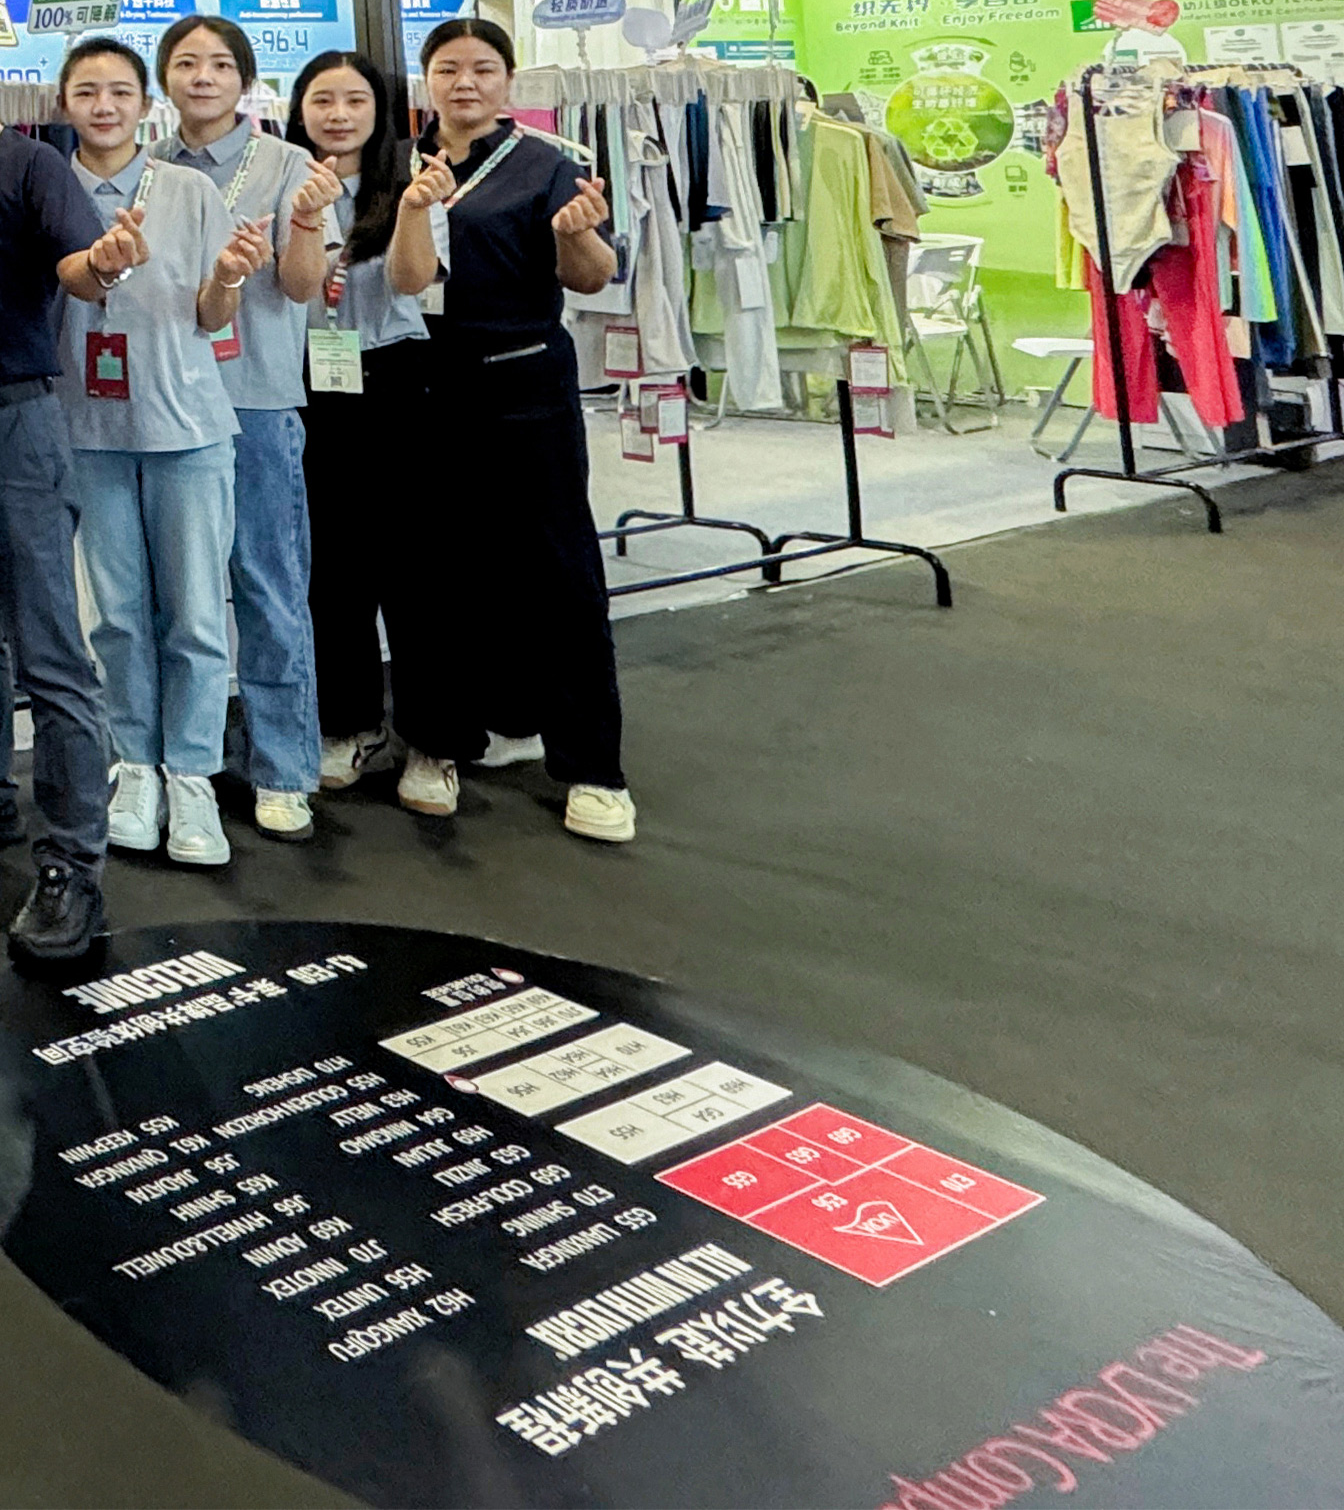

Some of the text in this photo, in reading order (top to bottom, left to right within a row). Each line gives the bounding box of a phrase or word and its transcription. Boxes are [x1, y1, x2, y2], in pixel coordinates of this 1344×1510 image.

[835, 7, 1060, 34] Beyond Knit Enjoy Freedom
[62, 950, 247, 1014] WELCOME
[313, 1055, 353, 1074] H70
[211, 1072, 386, 1139] H55 GOLDEN HORIZON
[329, 1088, 421, 1128] H63 WELLY
[339, 1107, 455, 1154] G64 MINGMAO
[58, 1115, 180, 1164] K55 KEEPWIN
[392, 1124, 494, 1168] H69 JULIAN
[608, 1123, 644, 1141] H55
[784, 1146, 821, 1165] G63
[827, 1126, 862, 1145] G69
[74, 1133, 211, 1189] K61 QINXINGFA
[124, 1153, 241, 1205] J56 JIADATAI
[432, 1144, 531, 1188] G63 JINZILI
[721, 1170, 758, 1190] G55
[939, 1172, 977, 1193] E70
[169, 1173, 279, 1222] K65 SHINIH
[430, 1164, 571, 1228] G69 COOL-FRESH
[501, 1184, 615, 1237] E70 SHINING
[112, 1194, 311, 1279] J66 HYWELL&DUWELL
[241, 1216, 353, 1268] K69 ADWIN
[519, 1207, 657, 1271] G55 LIANXINGFA
[678, 1242, 753, 1281] ALL
[261, 1239, 388, 1301] J70 INNOTEX
[312, 1263, 433, 1322] H56 UNITEX
[653, 1259, 719, 1295] IN
[595, 1271, 694, 1323] WITH
[328, 1288, 476, 1362] H62 XIANGQIFU
[495, 1277, 825, 1456] 全力以赴 共创新程
[1134, 1323, 1267, 1380] The
[878, 1436, 1080, 1510] Comp
